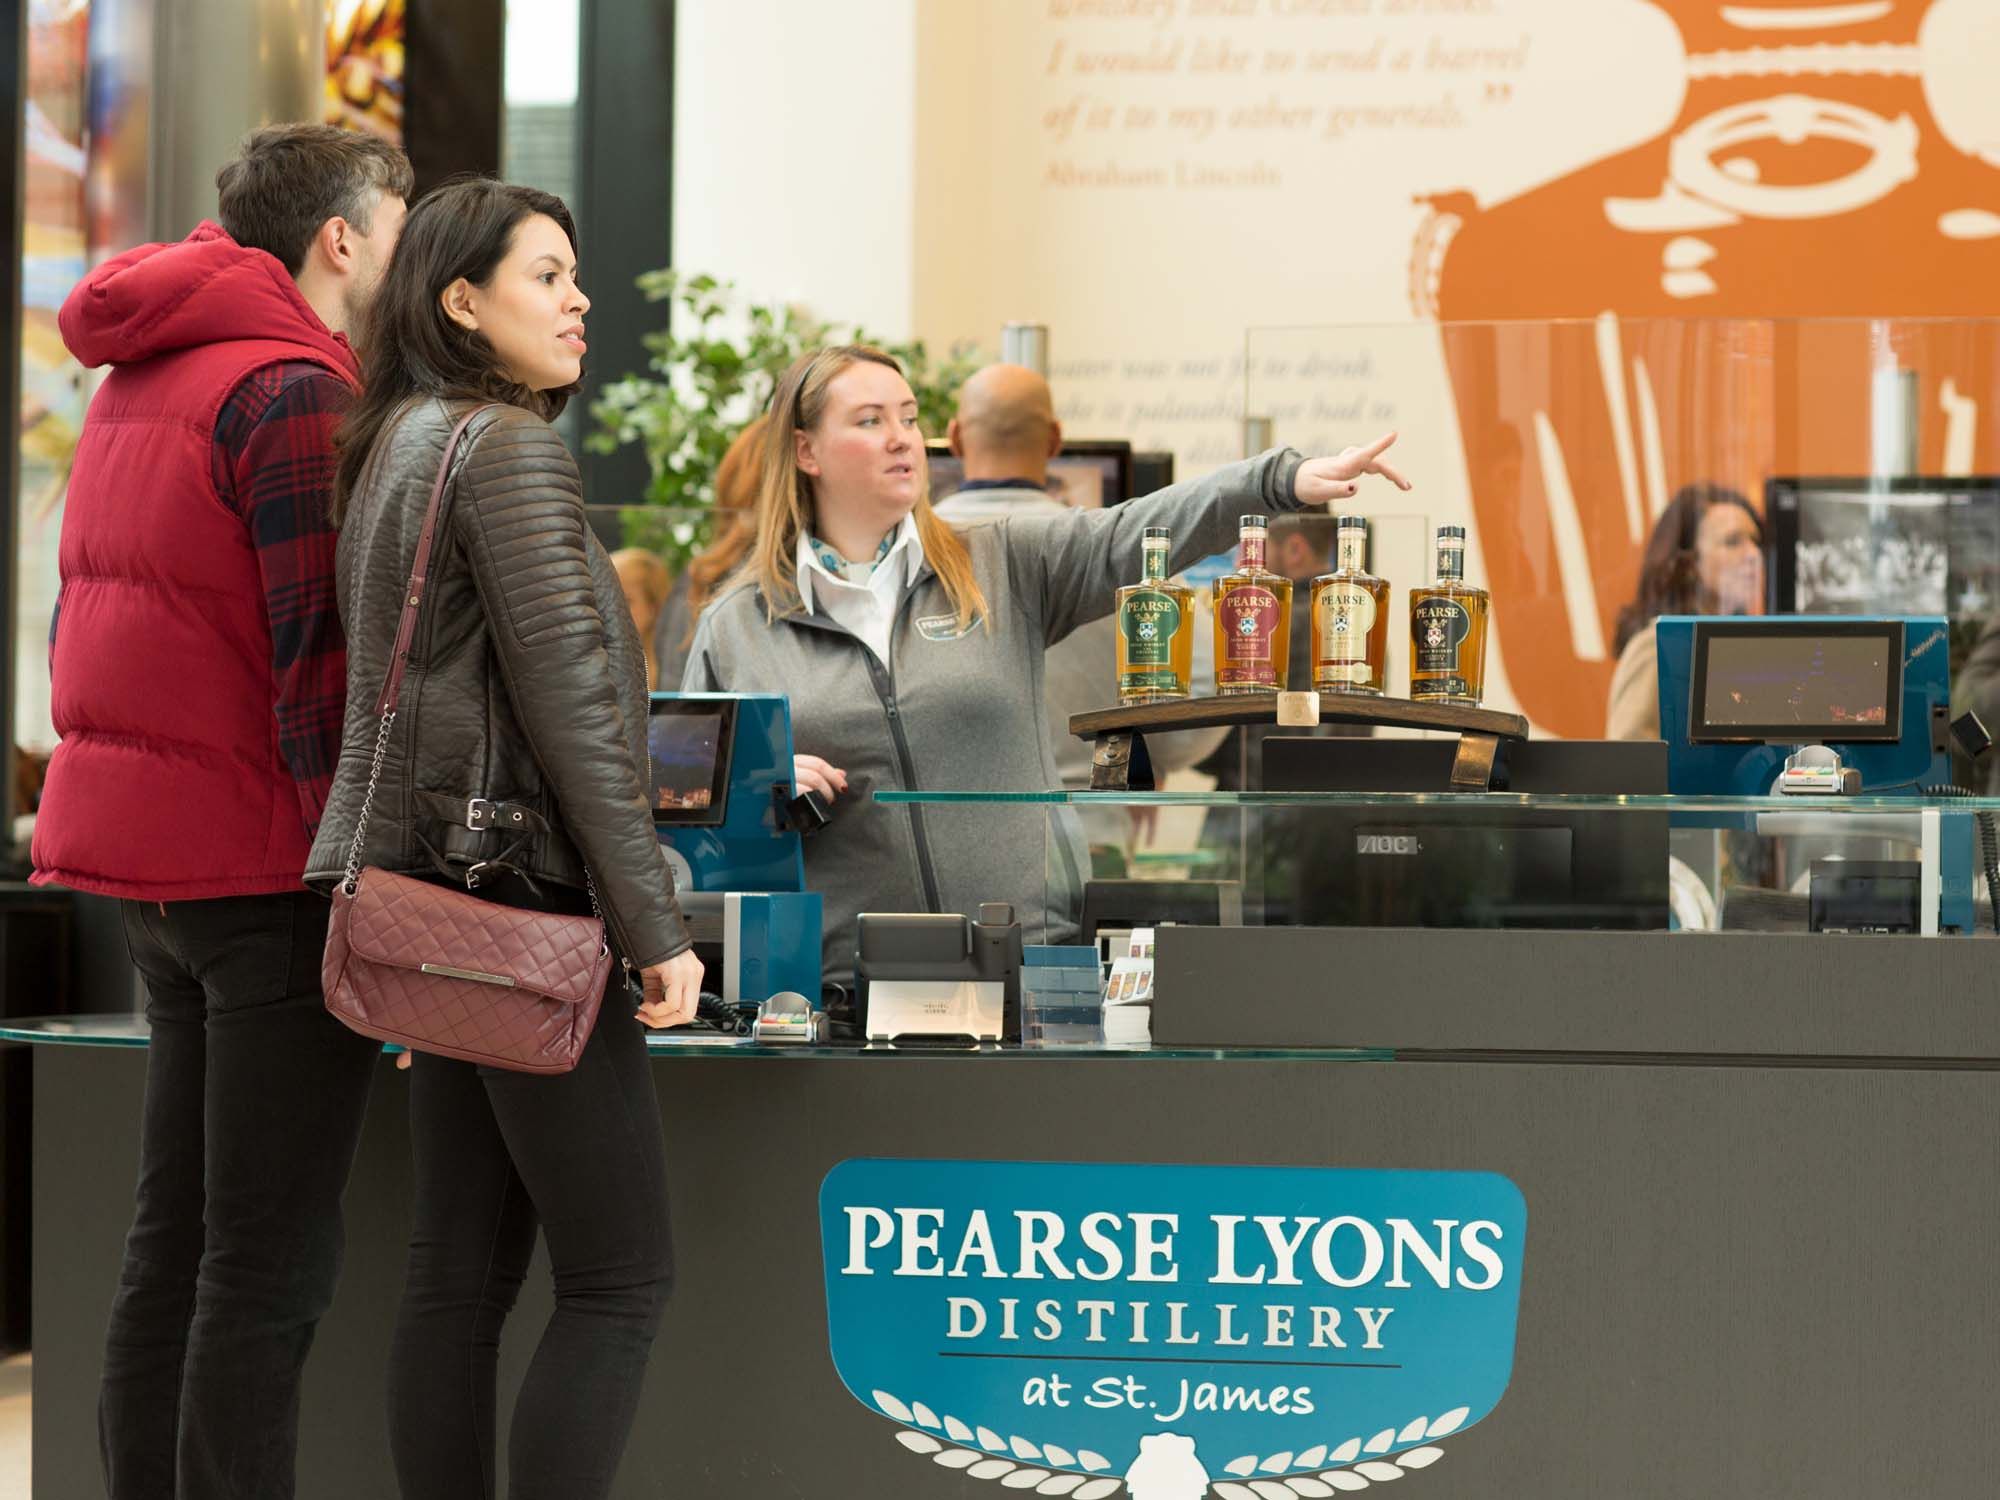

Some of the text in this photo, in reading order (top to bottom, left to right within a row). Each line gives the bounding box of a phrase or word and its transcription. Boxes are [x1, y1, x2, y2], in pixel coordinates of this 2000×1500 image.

[1073, 38, 1183, 75] would
[1262, 50, 1295, 75] to
[1424, 34, 1531, 73] barrel
[1167, 105, 1217, 141] my
[1228, 96, 1315, 129] other
[1126, 601, 1172, 613] PEARSE
[1227, 596, 1272, 608] PEARSE
[1321, 595, 1366, 606] PEARSE
[1416, 607, 1460, 619] PEARSE
[841, 1206, 1503, 1290] PEARSE LYONS
[946, 1297, 1394, 1349] DISTILLERY
[1023, 1374, 1316, 1422] at St. James
